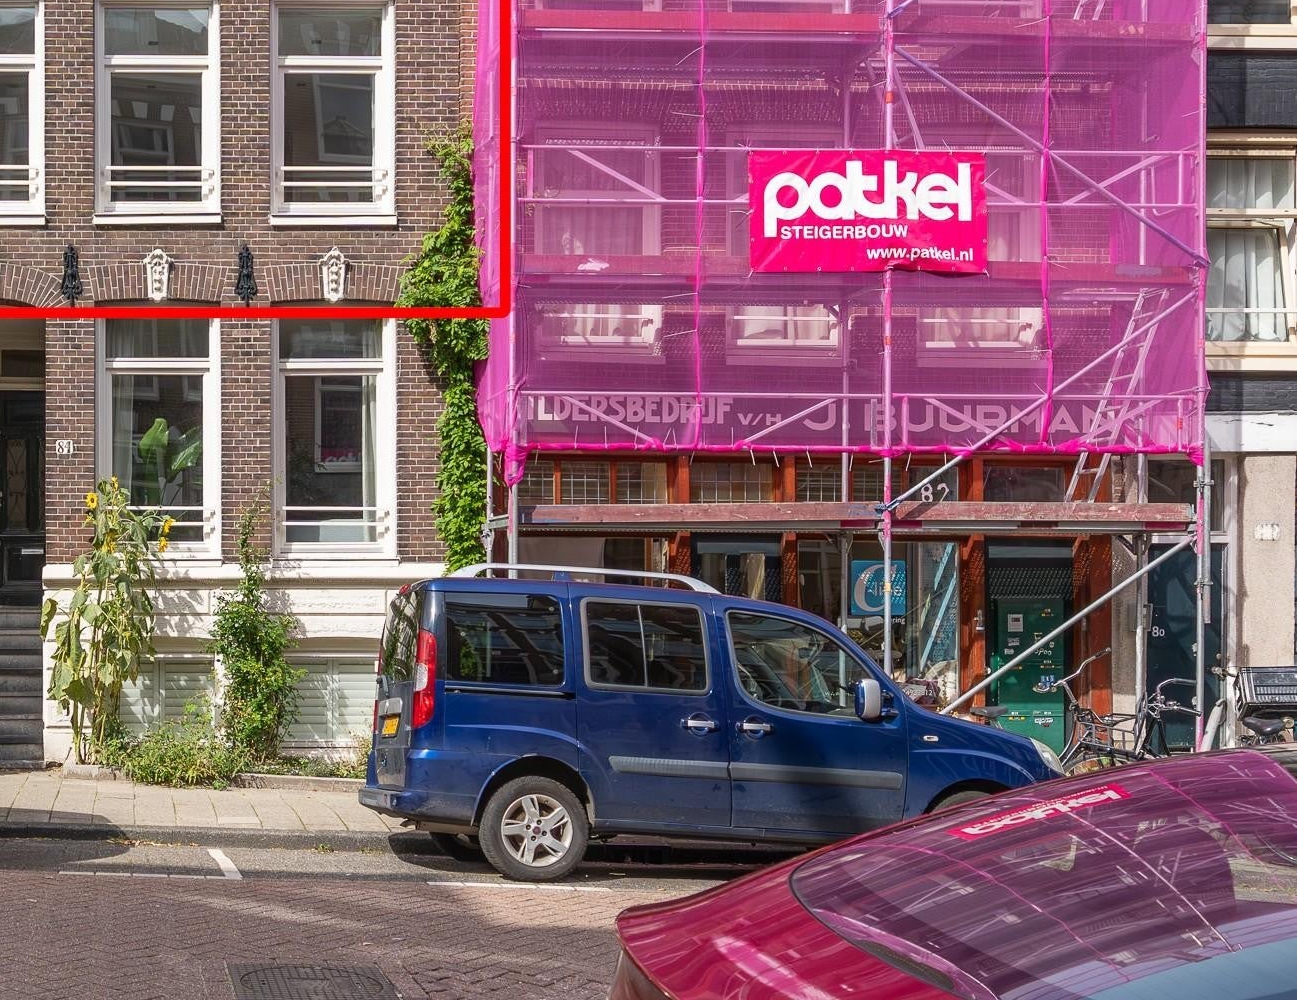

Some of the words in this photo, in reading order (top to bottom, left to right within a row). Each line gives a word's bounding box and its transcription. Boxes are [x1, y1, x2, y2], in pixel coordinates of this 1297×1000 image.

[764, 160, 972, 238] patkel
[781, 225, 908, 239] STEIGERBOUW
[867, 246, 973, 262] www.patkel.nl
[57, 441, 71, 454] 84
